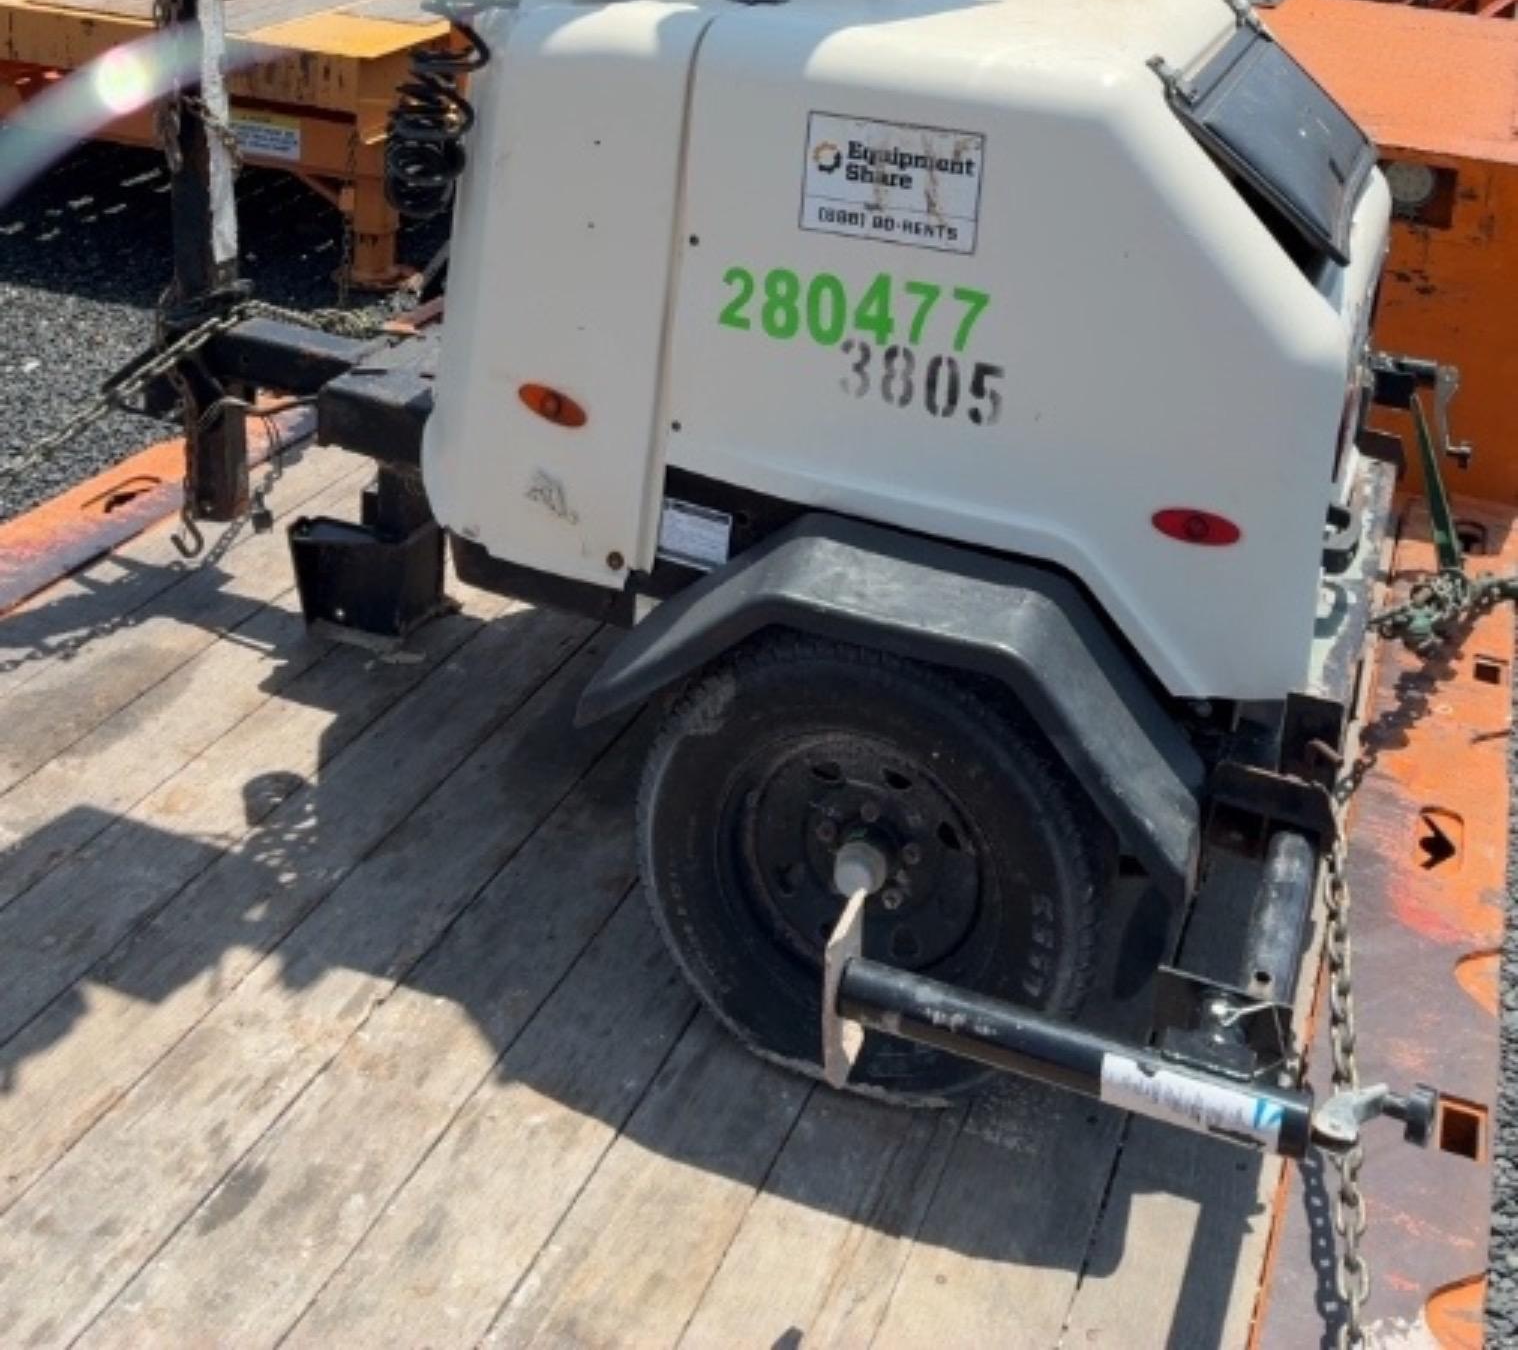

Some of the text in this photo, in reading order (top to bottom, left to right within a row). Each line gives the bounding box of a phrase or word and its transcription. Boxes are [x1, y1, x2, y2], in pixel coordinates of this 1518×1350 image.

[845, 162, 913, 190] Share
[848, 140, 976, 178] Equipment
[718, 266, 990, 352] 280477
[839, 338, 1004, 426] 3805
